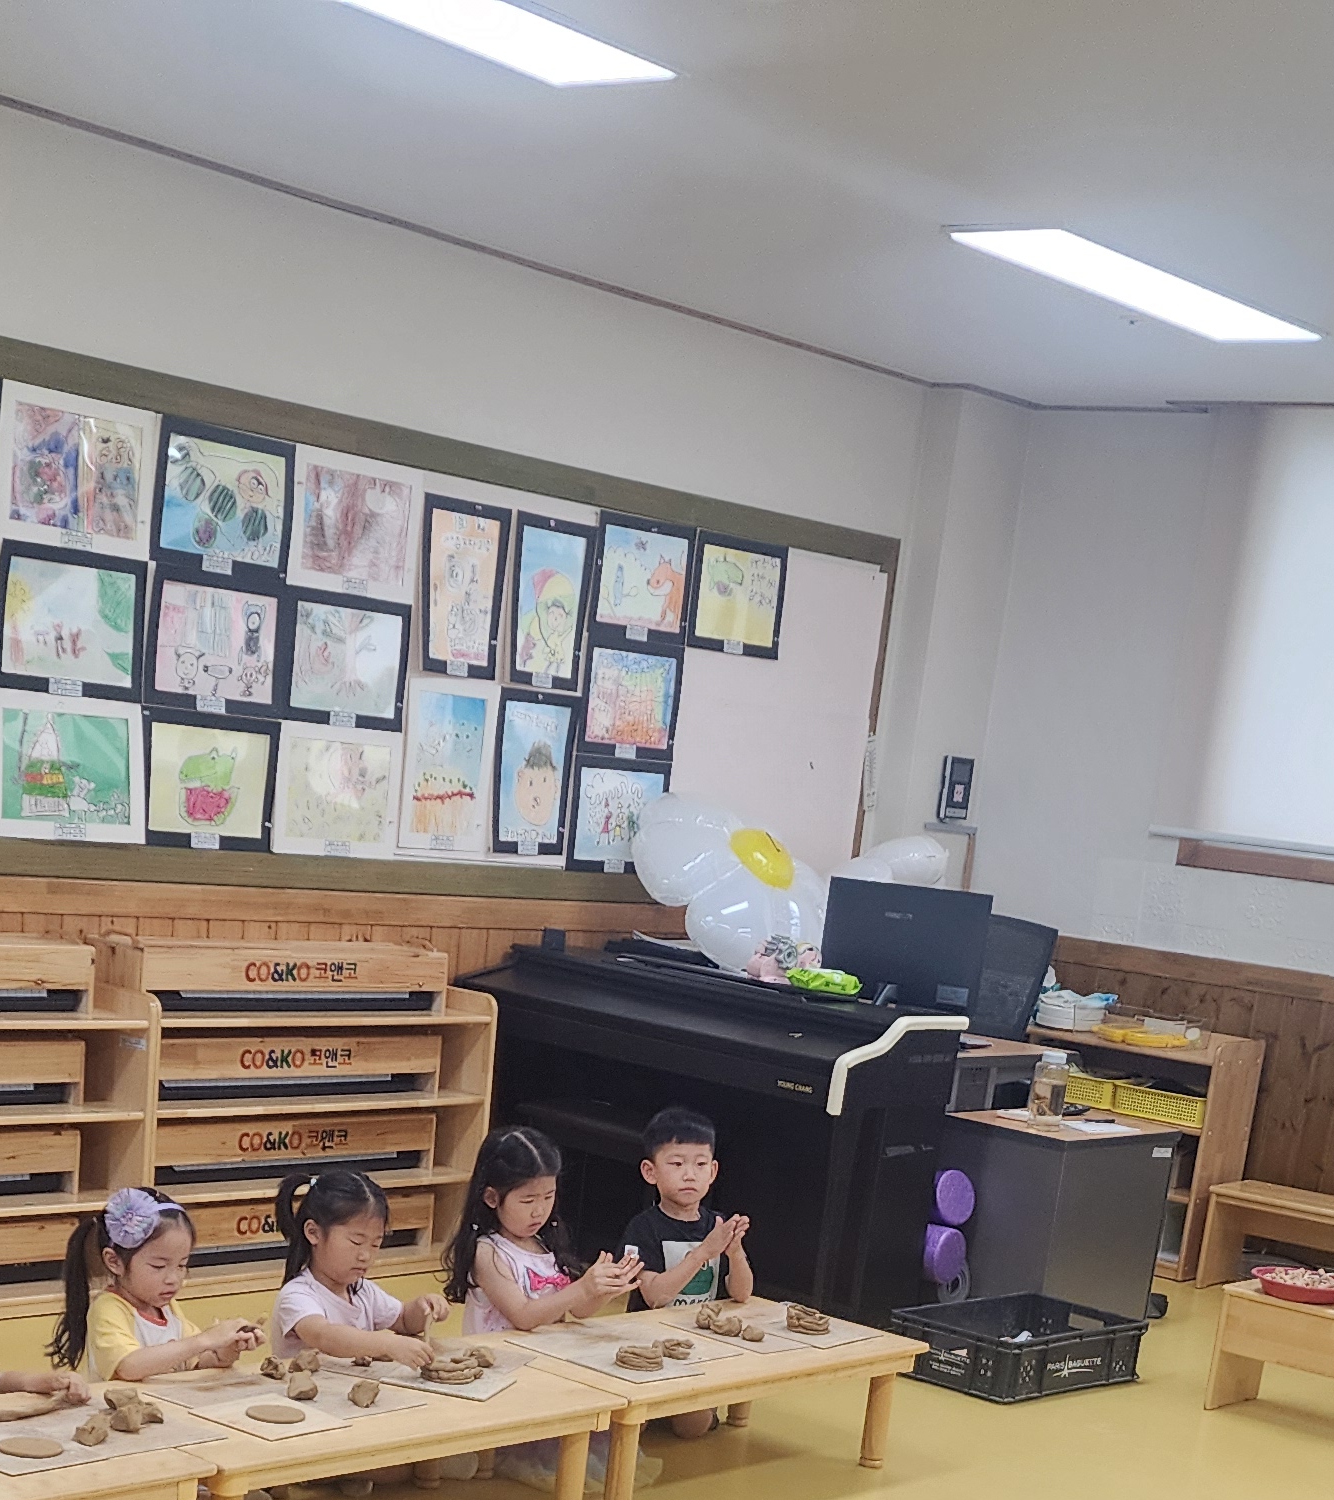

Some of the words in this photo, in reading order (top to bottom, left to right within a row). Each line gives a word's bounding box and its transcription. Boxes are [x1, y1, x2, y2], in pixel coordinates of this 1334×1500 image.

[245, 961, 311, 982] CO&KO
[314, 961, 358, 982] 코앤코
[240, 1049, 306, 1070] CO&KO
[308, 1048, 352, 1069] 코앤코
[238, 1131, 302, 1152] CO&KO
[306, 1129, 349, 1151] 코앤코
[236, 1214, 281, 1236] CO&
